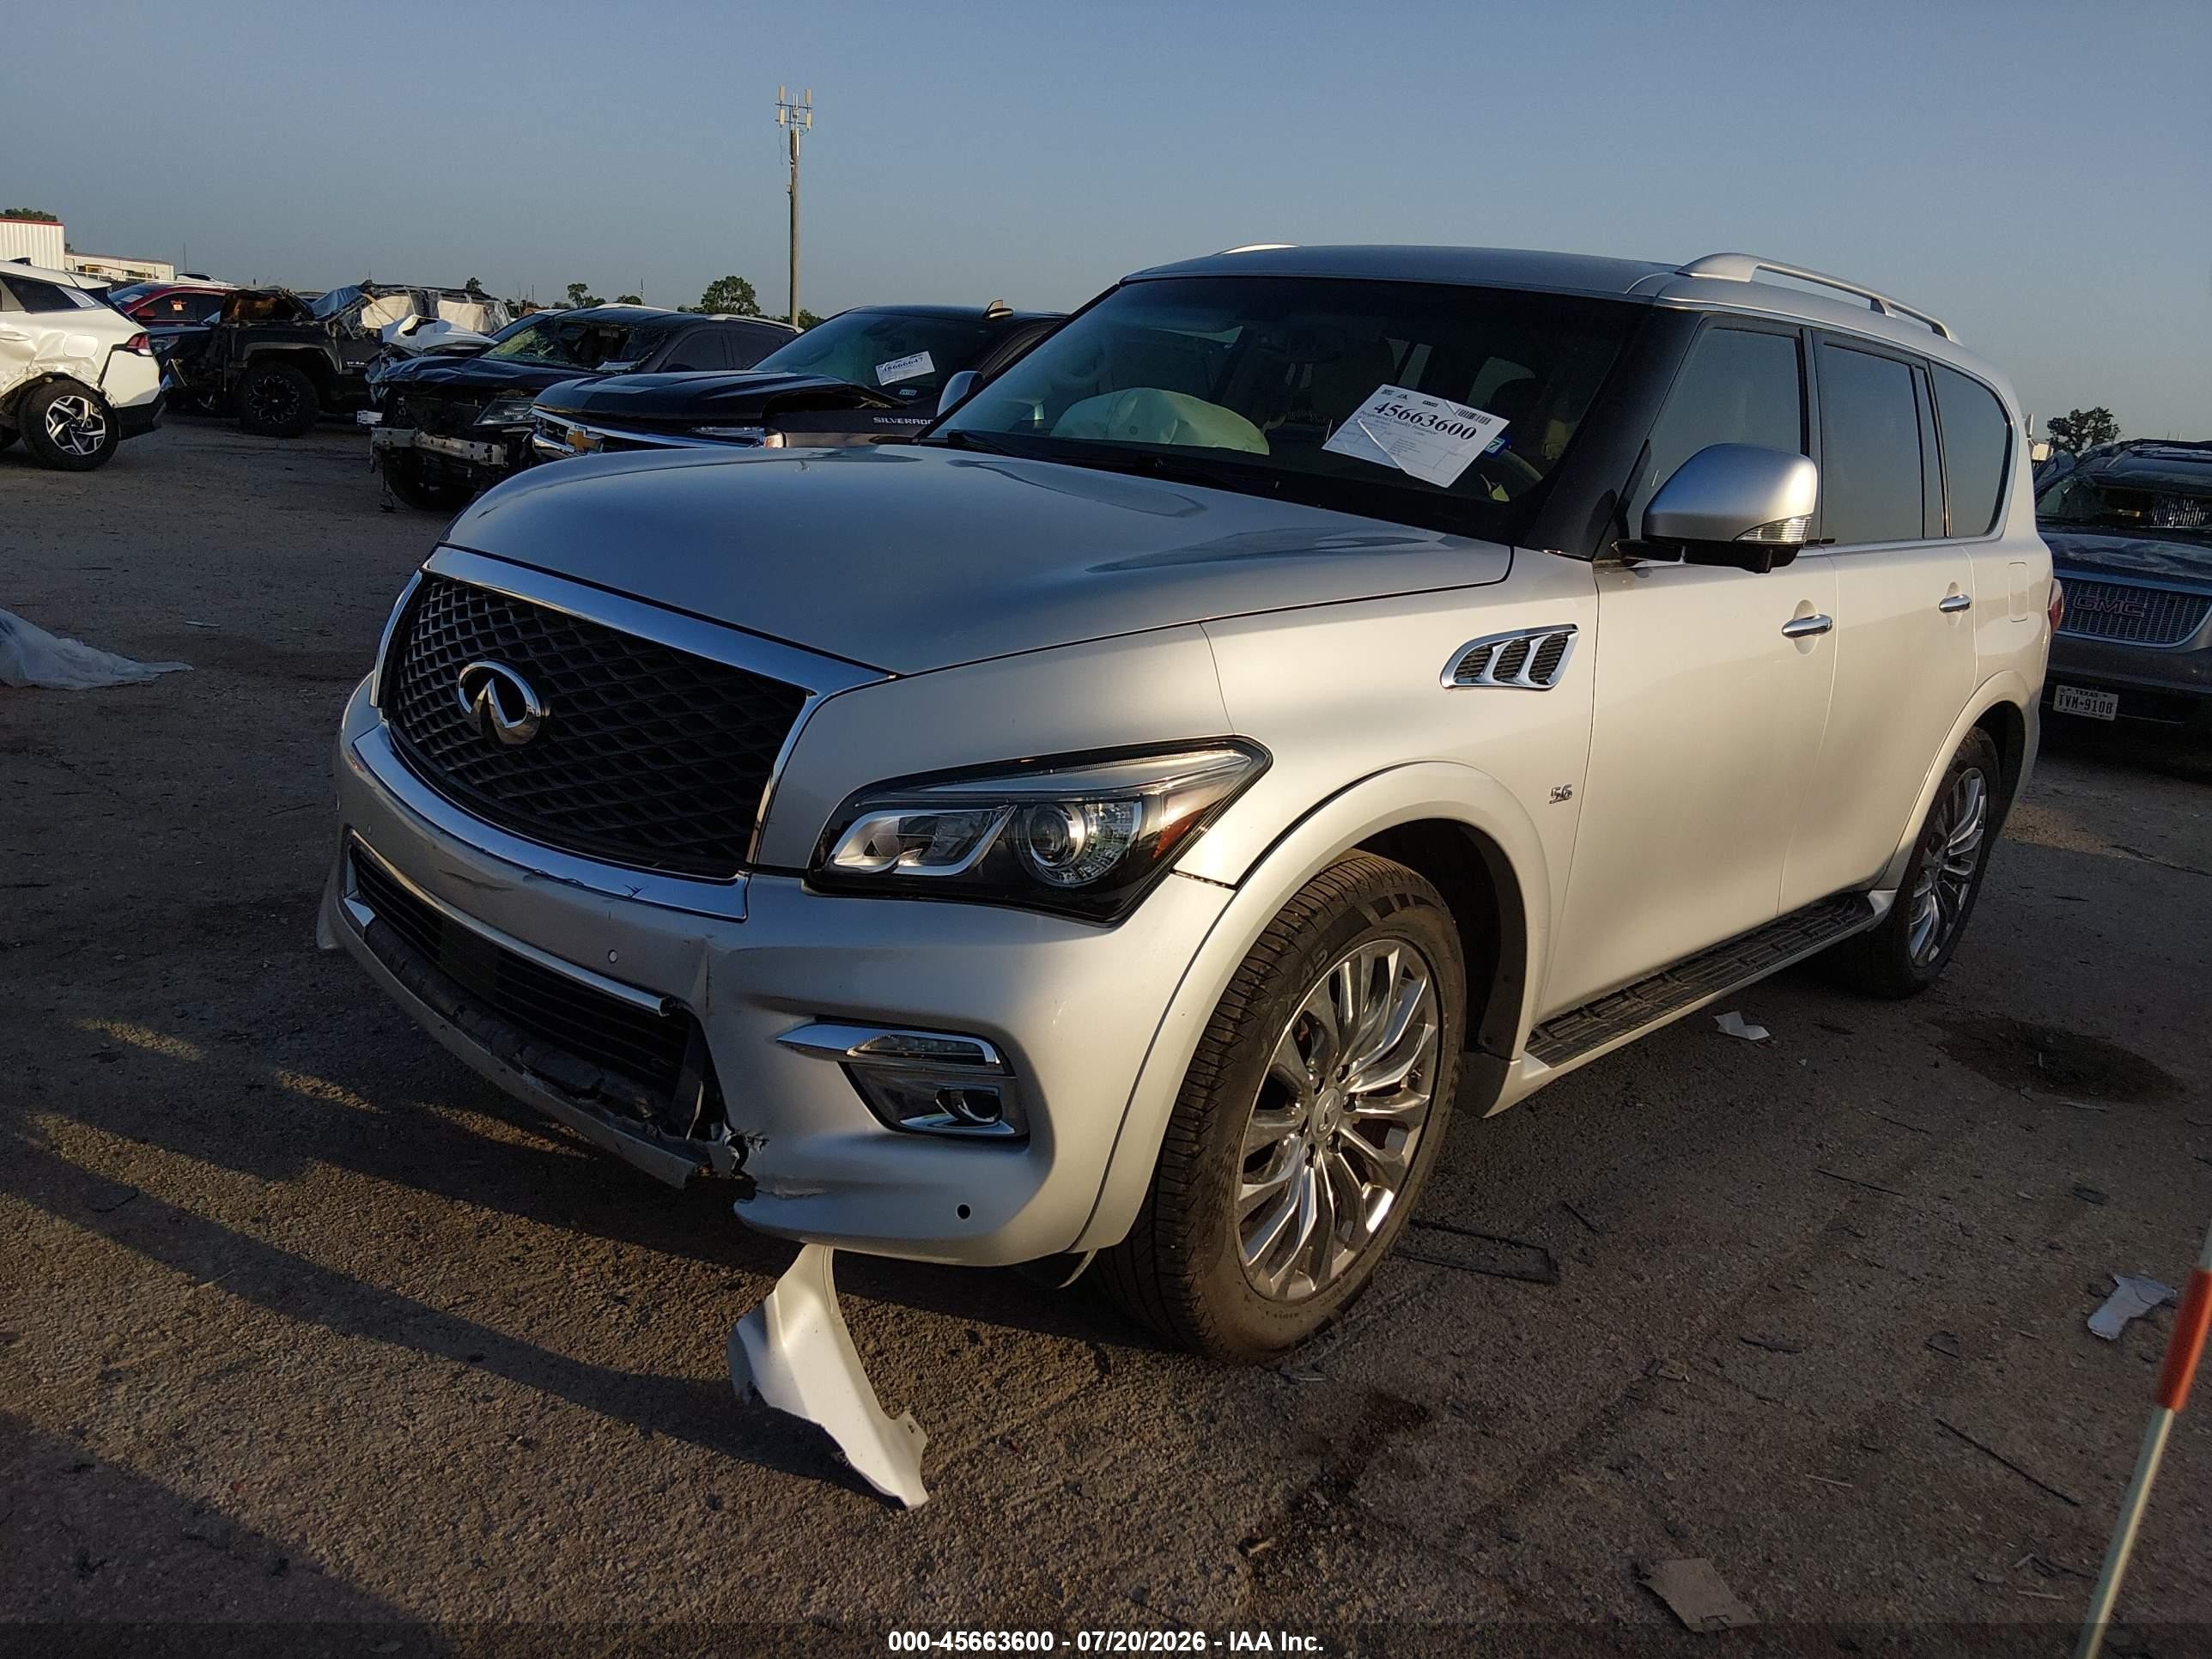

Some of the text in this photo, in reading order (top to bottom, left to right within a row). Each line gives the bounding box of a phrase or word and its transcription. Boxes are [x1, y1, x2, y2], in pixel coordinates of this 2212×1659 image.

[1374, 402, 1477, 441] 45663600
[2074, 595, 2145, 618] GMC
[2075, 690, 2099, 698] TEXAS
